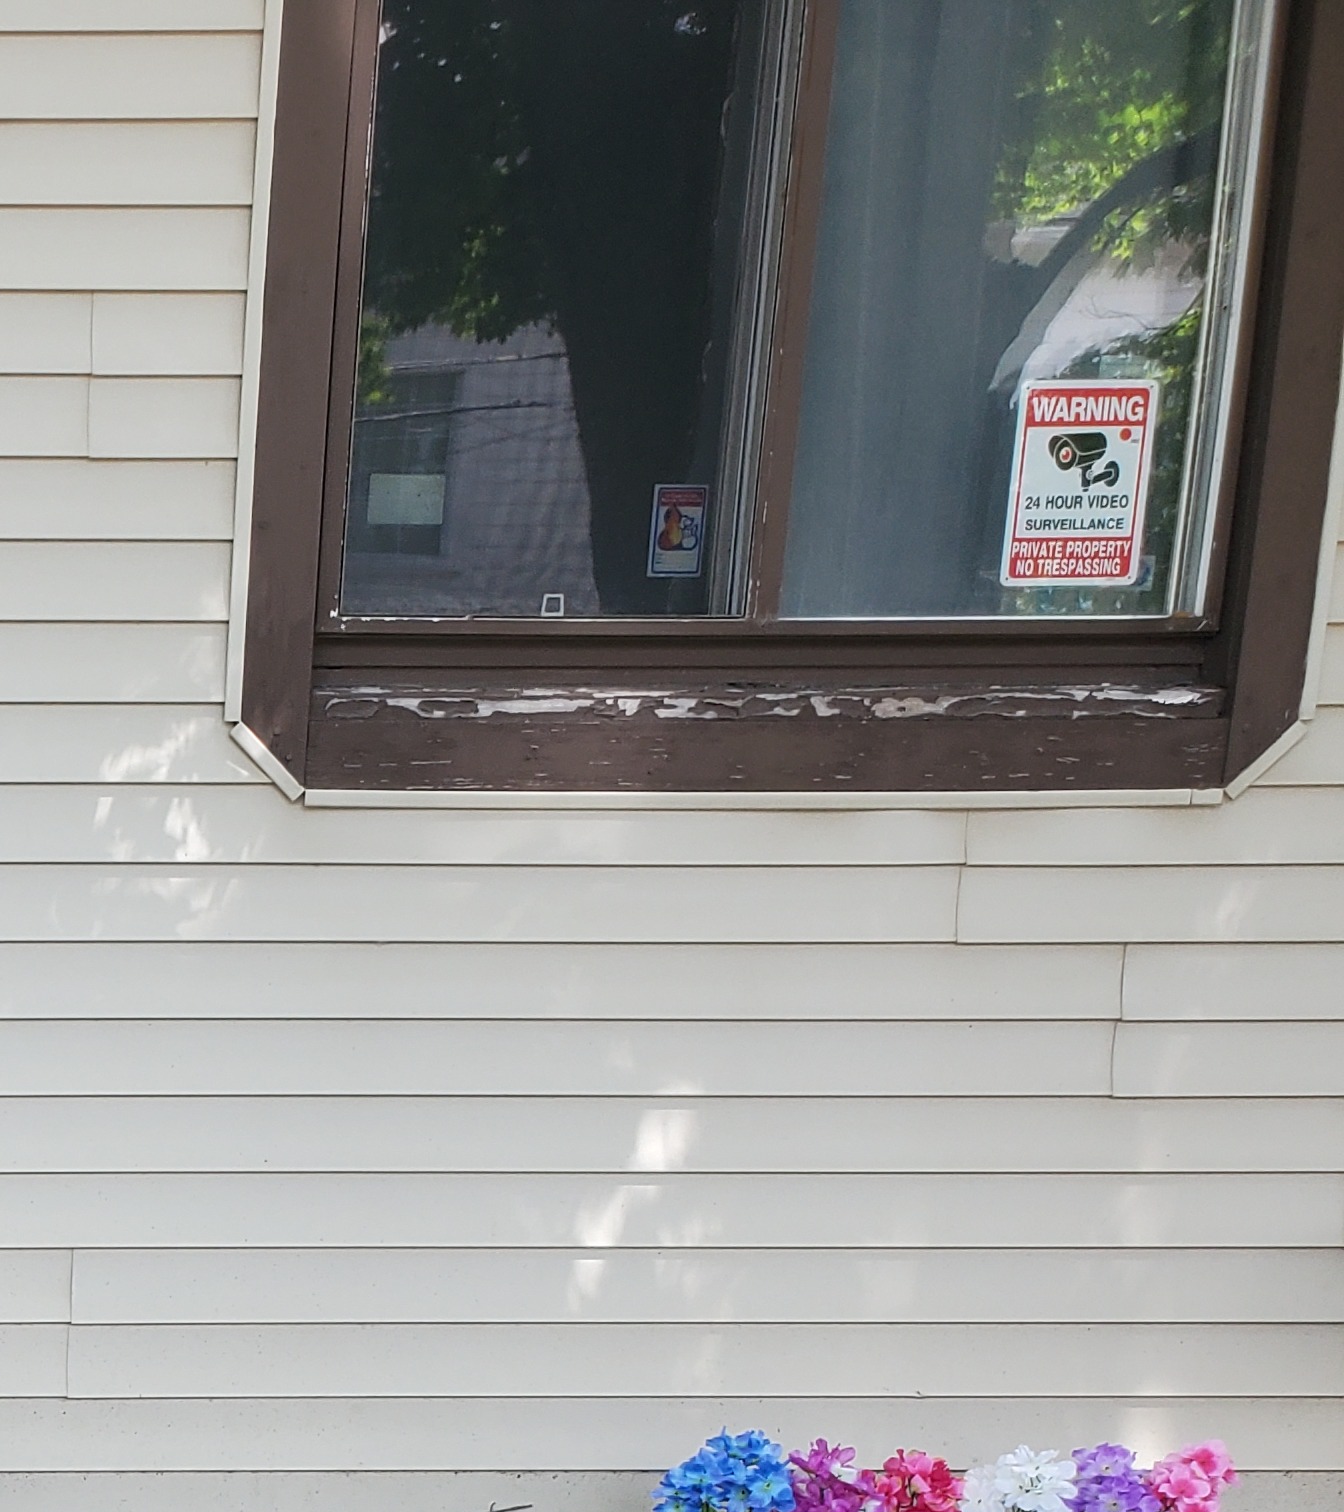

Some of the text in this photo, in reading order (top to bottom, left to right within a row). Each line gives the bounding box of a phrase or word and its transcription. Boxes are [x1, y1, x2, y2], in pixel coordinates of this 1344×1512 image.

[1032, 395, 1145, 422] WARNING
[1024, 494, 1129, 510] 24 HOUR VIDEO
[1024, 517, 1125, 531] SURVEILLANCE
[1011, 540, 1132, 558] PRIVATE PROPERTY
[1015, 558, 1121, 575] NO TRESPASSING
